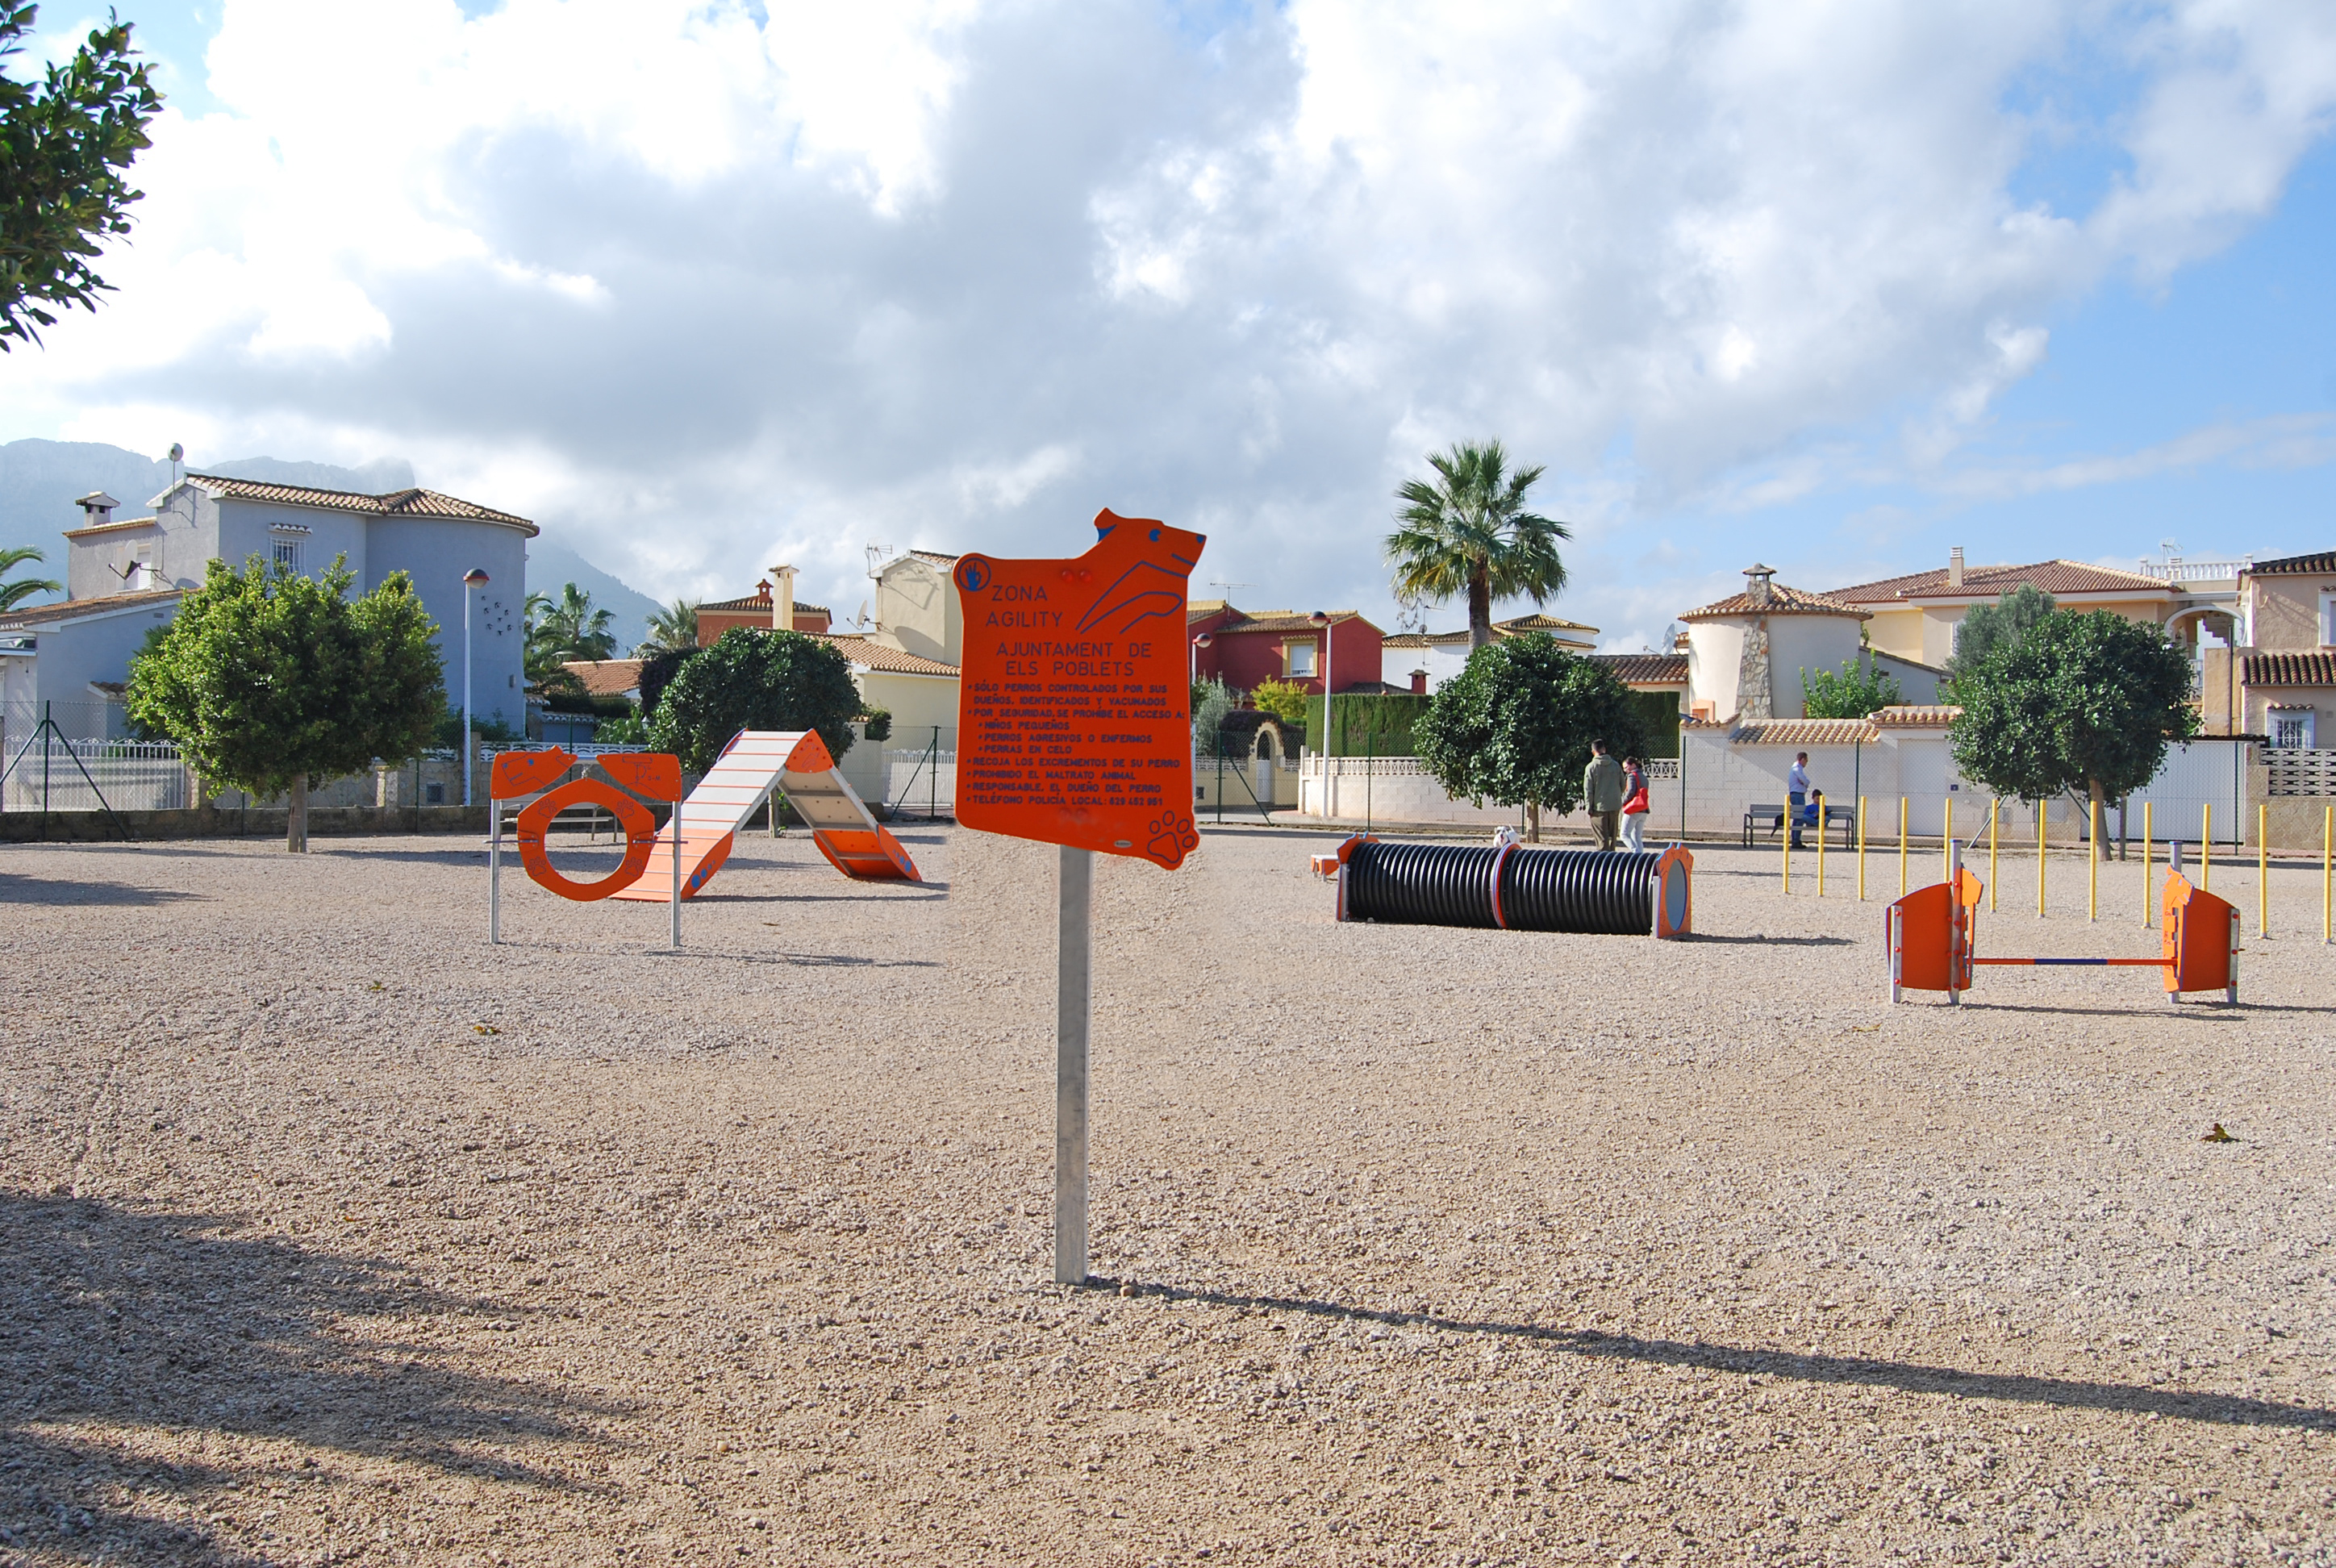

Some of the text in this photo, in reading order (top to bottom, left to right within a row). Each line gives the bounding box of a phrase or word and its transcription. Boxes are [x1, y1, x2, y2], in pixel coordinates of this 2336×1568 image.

[991, 585, 1048, 602] ZONA
[986, 611, 1063, 628] AGILITY
[996, 642, 1152, 657] AJUNTAMENT DE
[1006, 661, 1134, 677] ELS POBLETS
[974, 679, 1167, 693] SÓLO PERROS CONTROLADOS POR SUS
[1020, 696, 1090, 705] IDENTIFICADOS
[1096, 697, 1103, 705] Y
[1109, 697, 1166, 706] VACUNADOS
[974, 708, 993, 717] POR
[1057, 709, 1069, 718] SE
[1073, 706, 1113, 718] PROHÍBE
[1117, 710, 1128, 719] EL
[1133, 711, 1172, 719] ACCESO
[1175, 711, 1185, 719] A:
[985, 718, 1070, 730] NIÑOS PEQUEÑOS
[985, 733, 1153, 743] PERROS AGRESIVOS O ENFERMOS
[985, 744, 1072, 754] PERRAS EN CELO
[973, 757, 1180, 768] RECOJA LOS EXCREMENTOS DE SU PERRO
[973, 769, 1136, 780] PROHIBIDO EL MALTRATO ANIMAL
[1049, 783, 1061, 791] EL
[1067, 781, 1099, 792] DUEÑO
[1105, 784, 1123, 792] DEL
[1129, 784, 1162, 793] PERRO
[973, 791, 1023, 804] TELÉFONO
[1028, 792, 1066, 804] POLICÍA
[1072, 797, 1107, 805] LOCAL:
